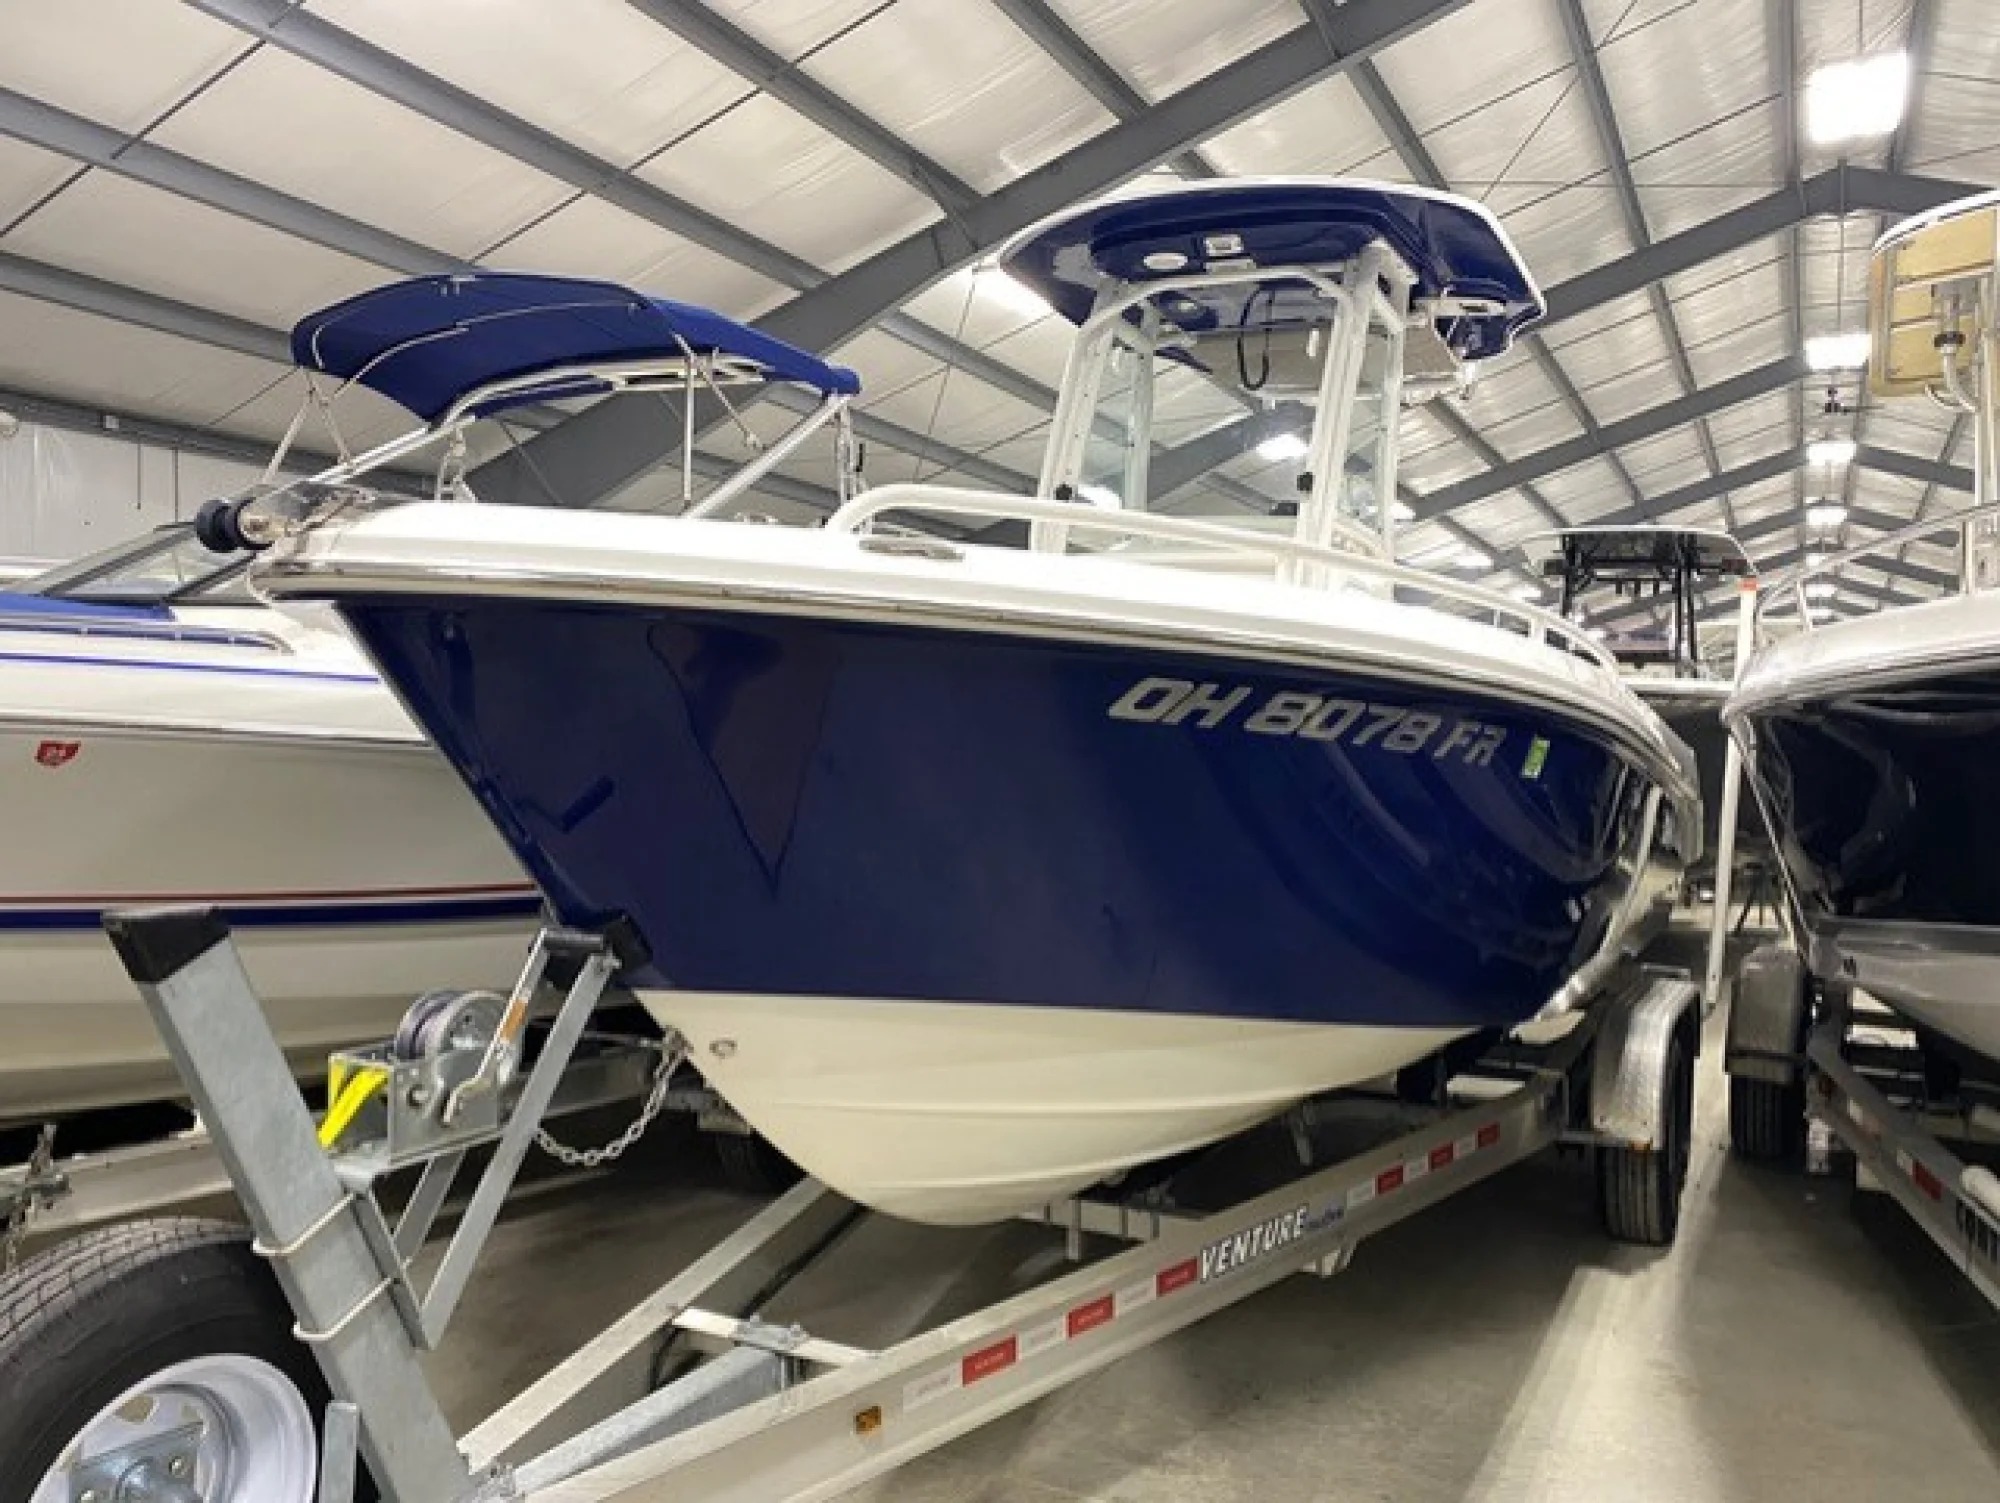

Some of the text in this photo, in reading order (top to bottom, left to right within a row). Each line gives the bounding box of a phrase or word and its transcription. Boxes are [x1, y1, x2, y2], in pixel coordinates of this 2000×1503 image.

[1107, 677, 1252, 728] OH
[1244, 693, 1442, 753] 8078
[1433, 719, 1506, 766] FR
[1201, 1206, 1309, 1282] VENTURE
